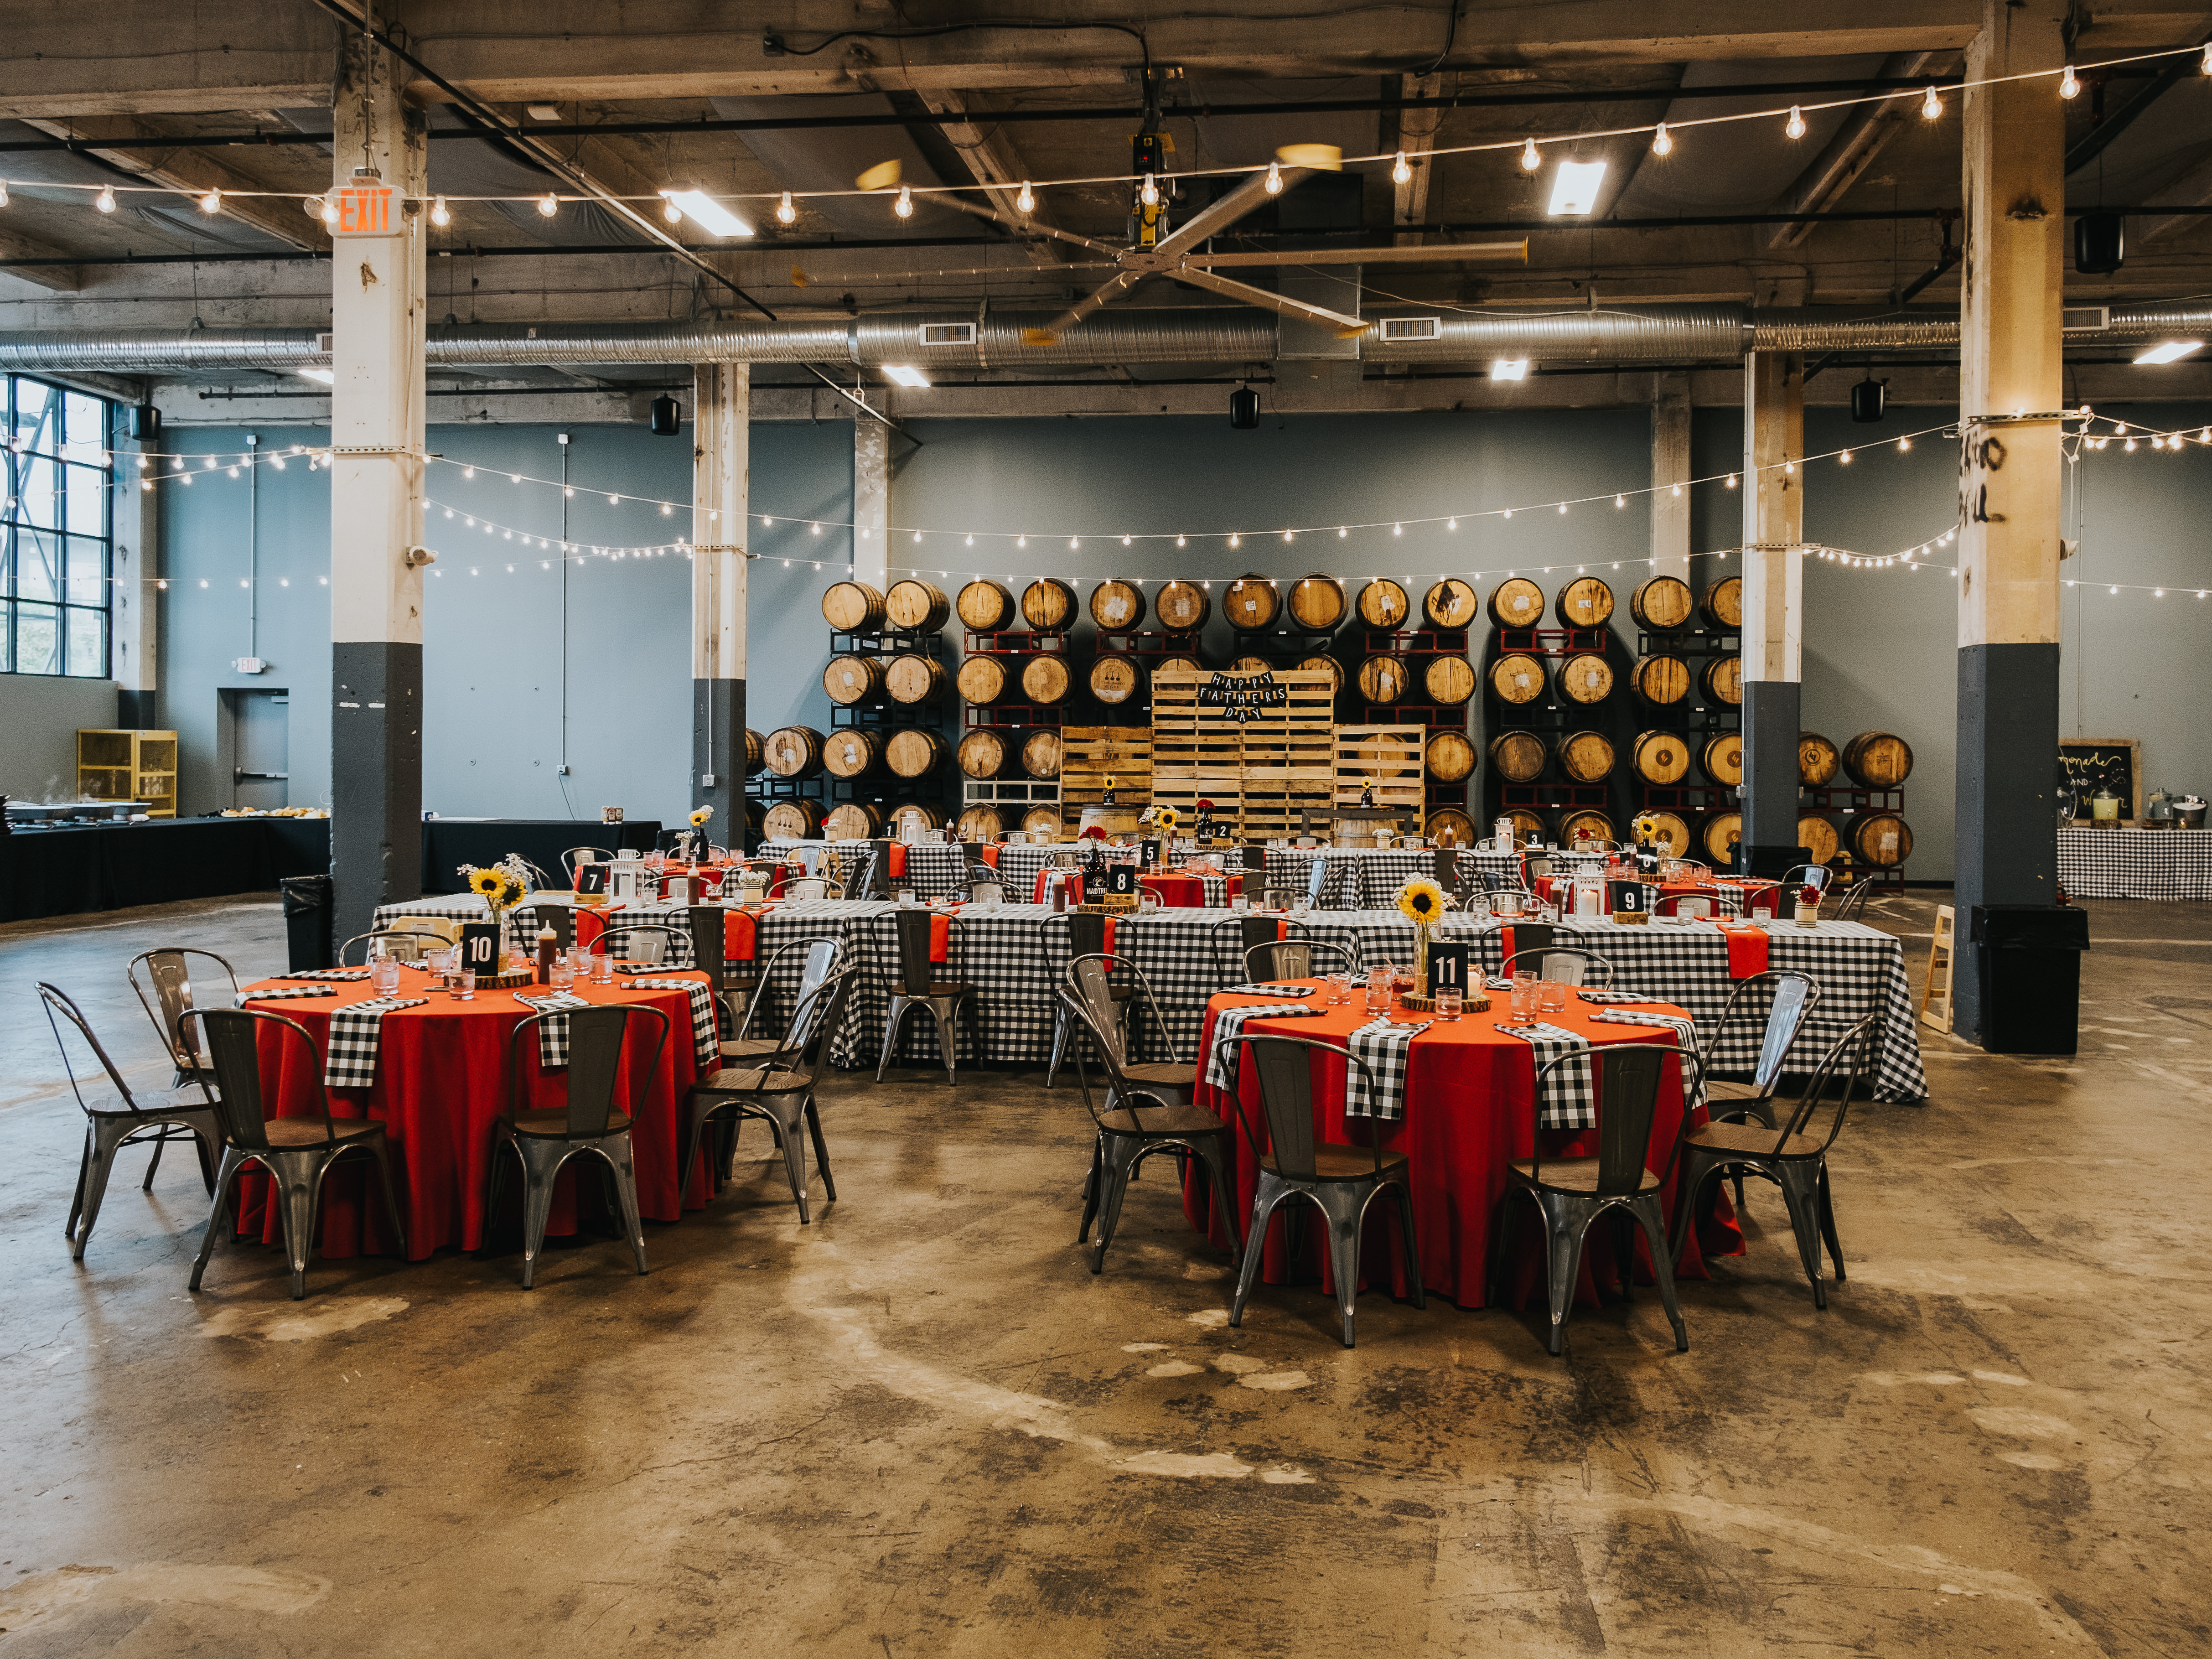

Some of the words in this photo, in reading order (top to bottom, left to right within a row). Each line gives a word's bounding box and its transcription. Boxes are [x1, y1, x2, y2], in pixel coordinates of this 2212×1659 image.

[340, 188, 393, 232] EXIT
[242, 659, 256, 671] EXIT
[1212, 672, 1272, 690] HAPPY
[1200, 688, 1285, 704] FATHERS
[1225, 707, 1260, 722] DAY
[887, 825, 891, 837] 1
[1219, 826, 1226, 836] 2
[1531, 834, 1538, 845] 3
[694, 842, 700, 855] 4
[1147, 847, 1154, 860] 5
[589, 874, 598, 890] 7
[1117, 873, 1126, 890] 8
[1625, 892, 1635, 910] 9
[470, 936, 491, 962] 10
[1435, 957, 1456, 984] 11
